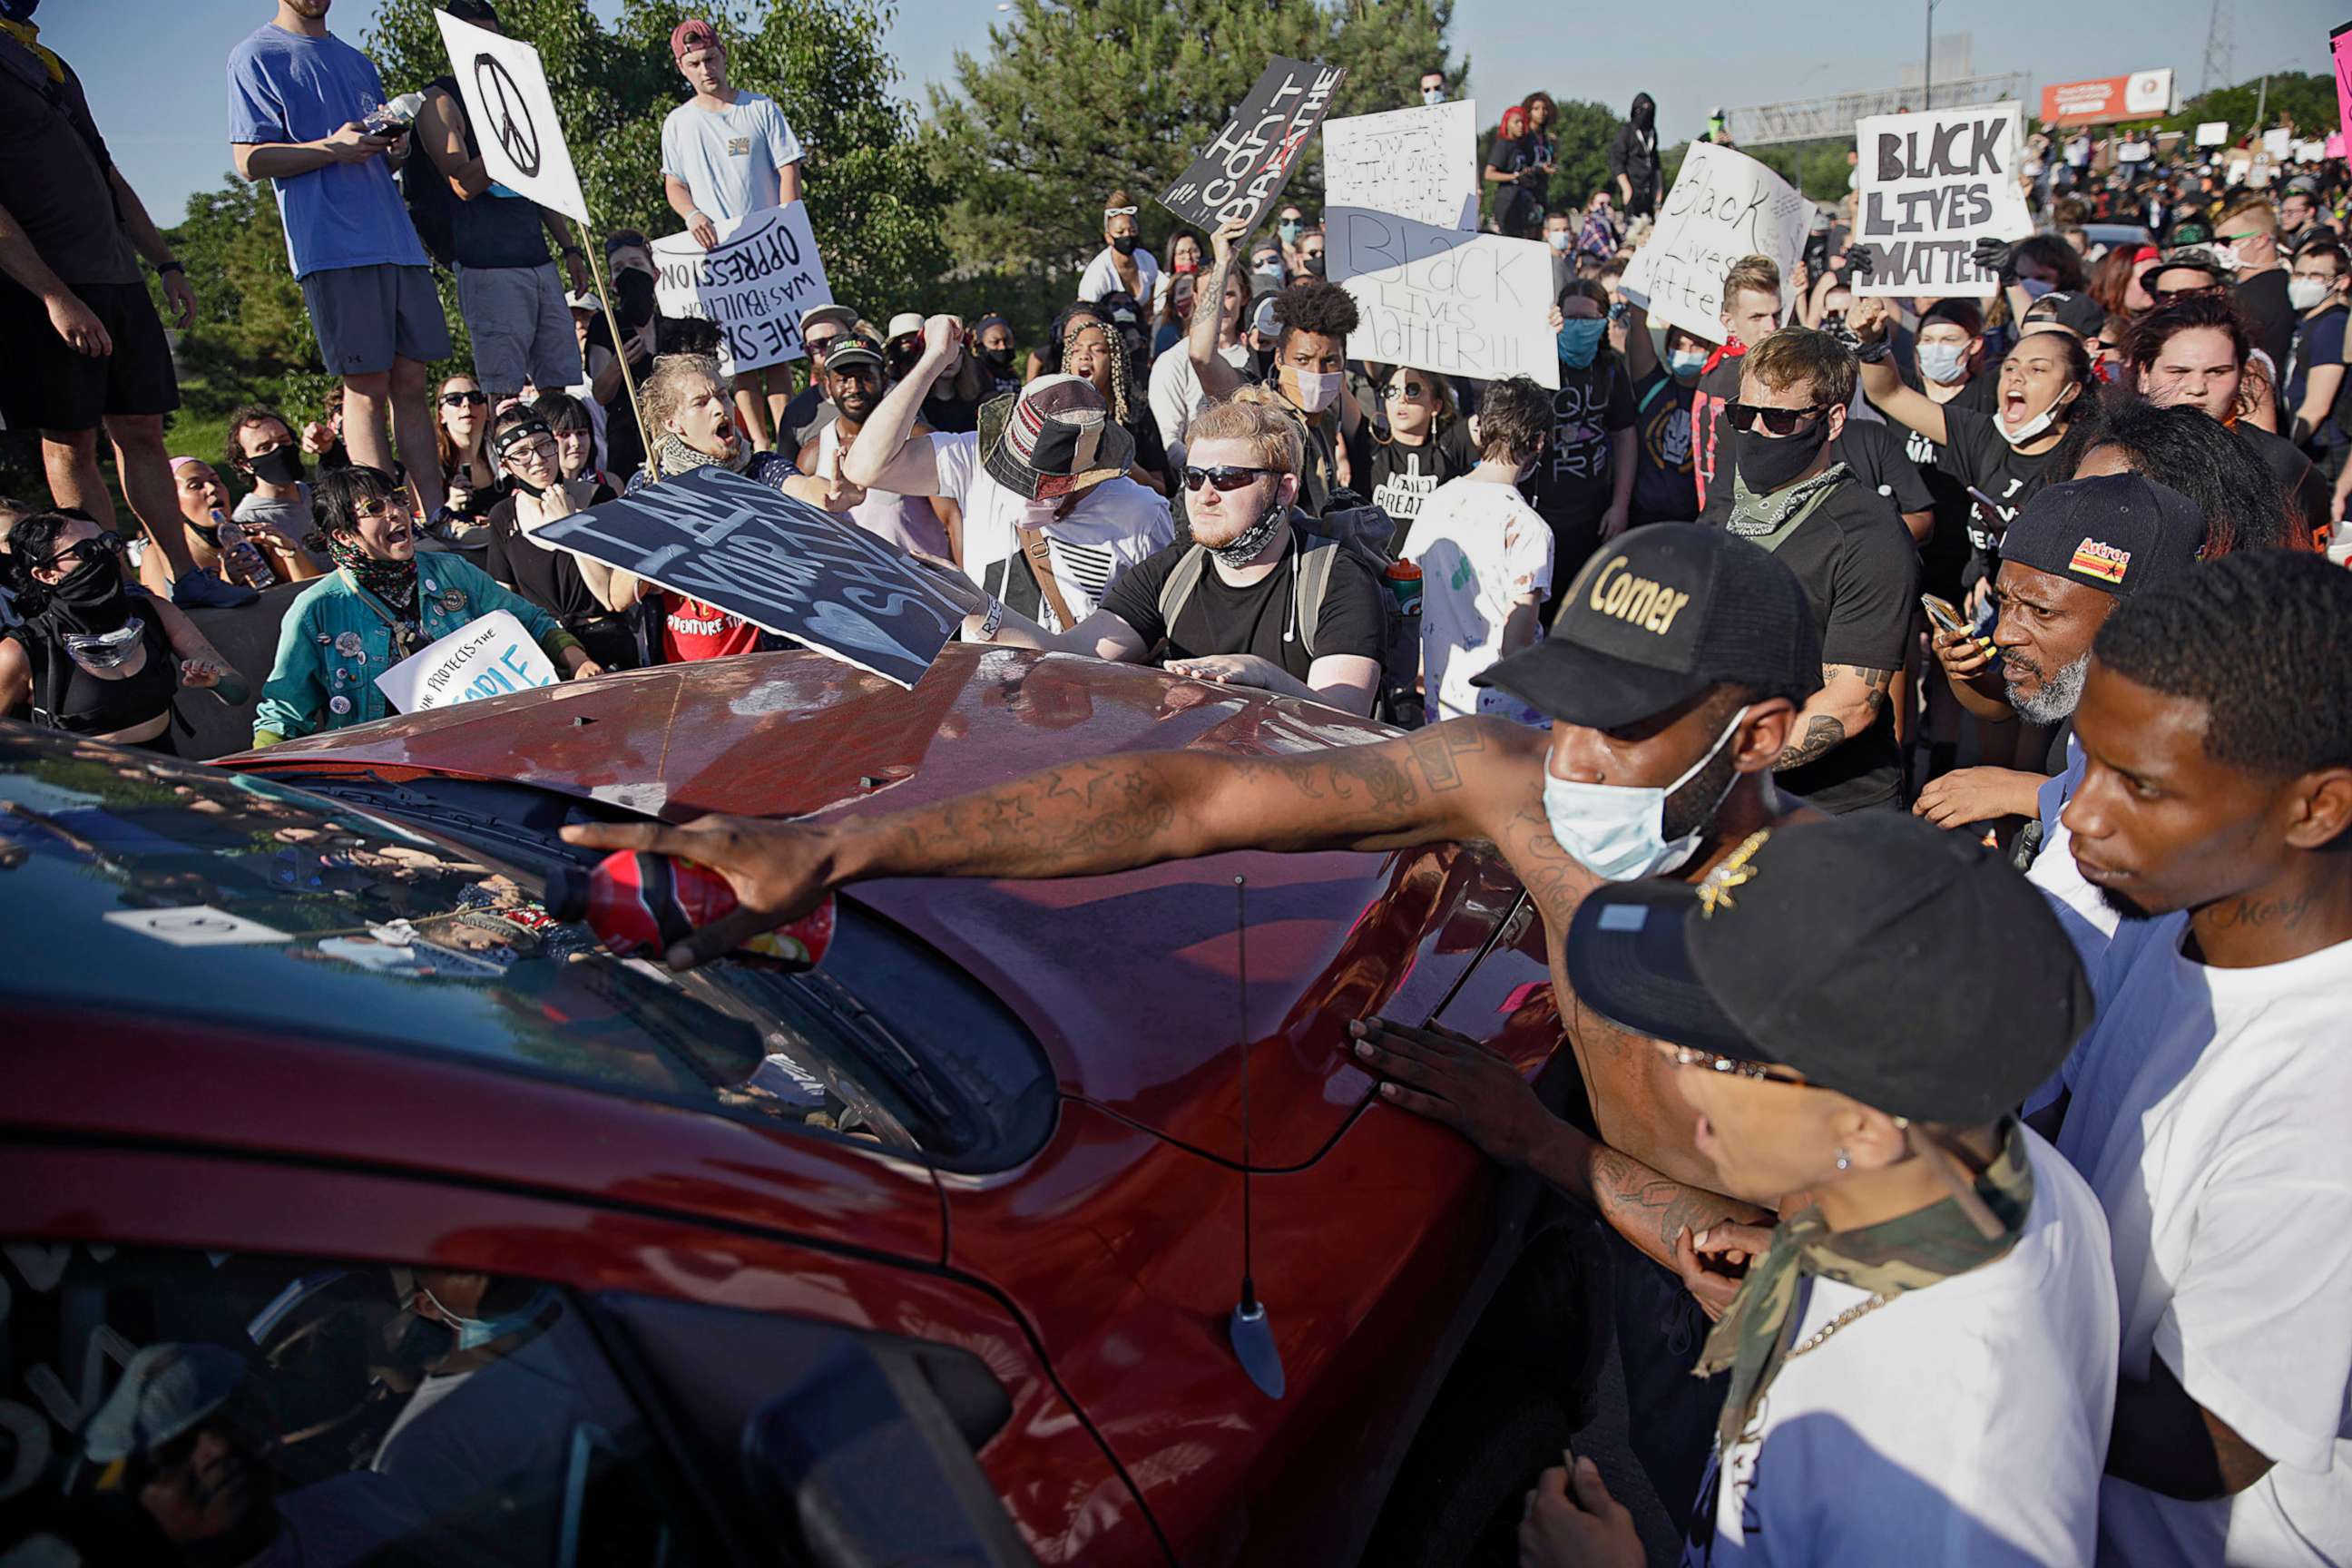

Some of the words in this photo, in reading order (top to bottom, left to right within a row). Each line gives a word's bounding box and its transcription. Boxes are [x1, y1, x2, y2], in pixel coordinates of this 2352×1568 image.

[1877, 117, 2007, 182] BLACK
[1865, 183, 1993, 236] LIVES
[662, 224, 800, 291] OPPRESSION
[769, 271, 816, 306] WAS
[1381, 282, 1476, 330] LIVES
[1377, 489, 1426, 516] BREAT
[669, 534, 825, 615] YOUR
[2077, 537, 2132, 564] Astros
[1590, 555, 1690, 635] Corner
[427, 643, 477, 692] PROTECTS
[473, 627, 497, 646] THE
